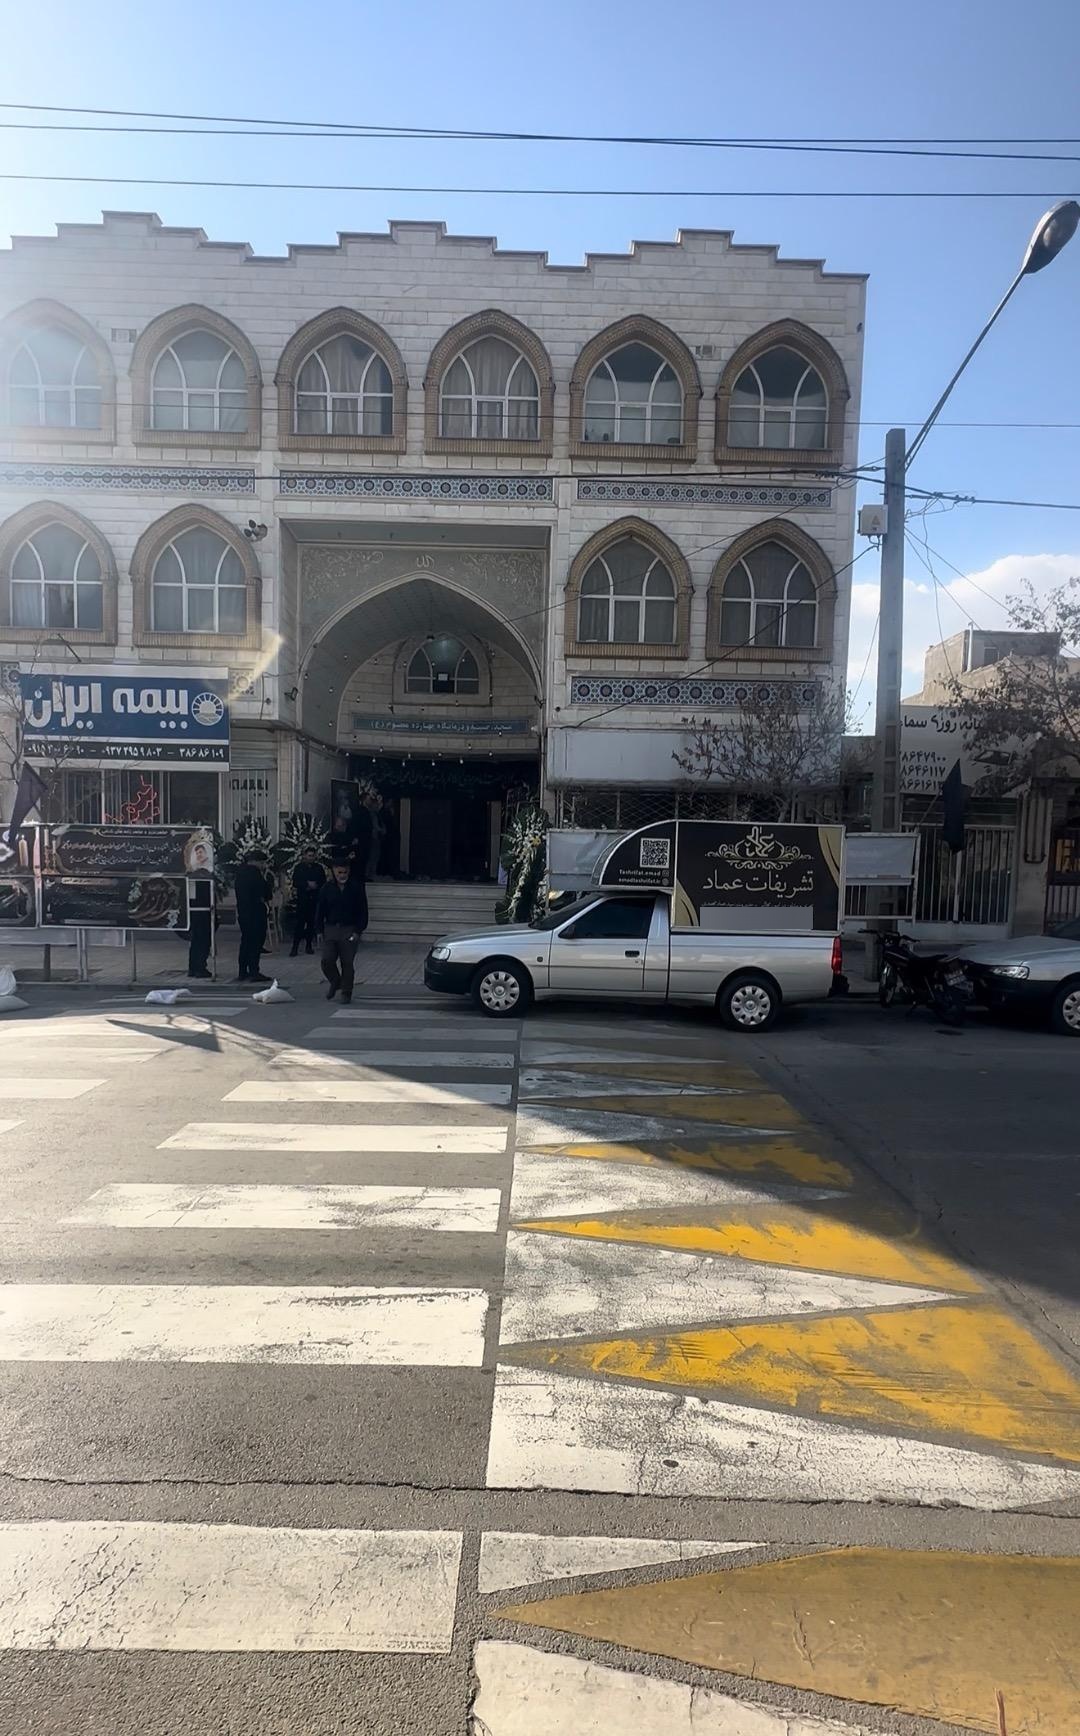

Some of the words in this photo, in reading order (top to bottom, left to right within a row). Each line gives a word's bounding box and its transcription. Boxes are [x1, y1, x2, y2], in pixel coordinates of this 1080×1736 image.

[25, 681, 102, 730] ایران
[113, 688, 188, 729] بیمه
[702, 869, 743, 891] عماد
[745, 870, 814, 898] تشریفات
